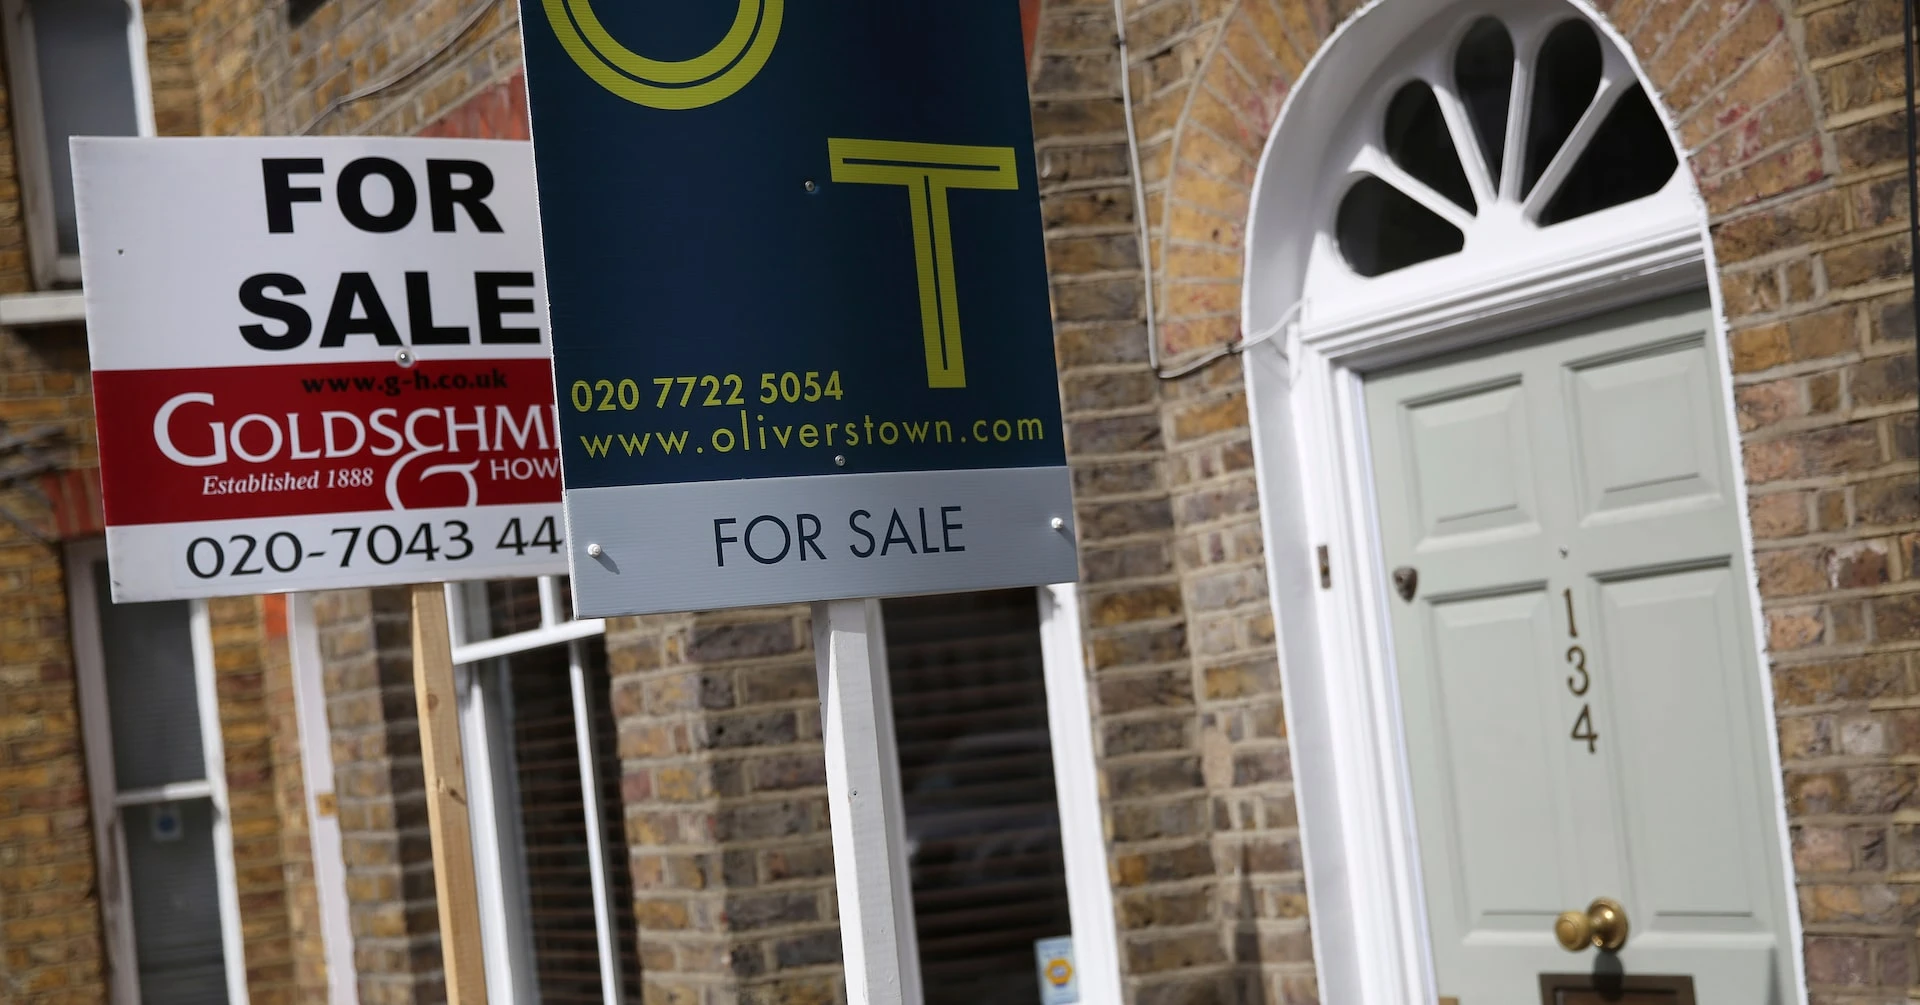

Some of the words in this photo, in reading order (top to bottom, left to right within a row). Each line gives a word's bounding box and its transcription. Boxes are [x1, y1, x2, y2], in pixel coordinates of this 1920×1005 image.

[261, 156, 504, 234] FOR
[238, 271, 541, 351] SALE
[302, 368, 508, 396] www.g-h.co.uk
[571, 378, 640, 413] 020
[653, 374, 745, 408] 7722
[759, 370, 844, 405] 5054
[580, 410, 1045, 459] www.oliverstown.com
[202, 470, 320, 495] Established
[326, 467, 373, 489] 1888
[490, 457, 560, 481] HOW
[186, 520, 474, 579] 020-7043
[495, 516, 563, 556] 44
[713, 514, 828, 567] FOR
[849, 506, 966, 559] SALE
